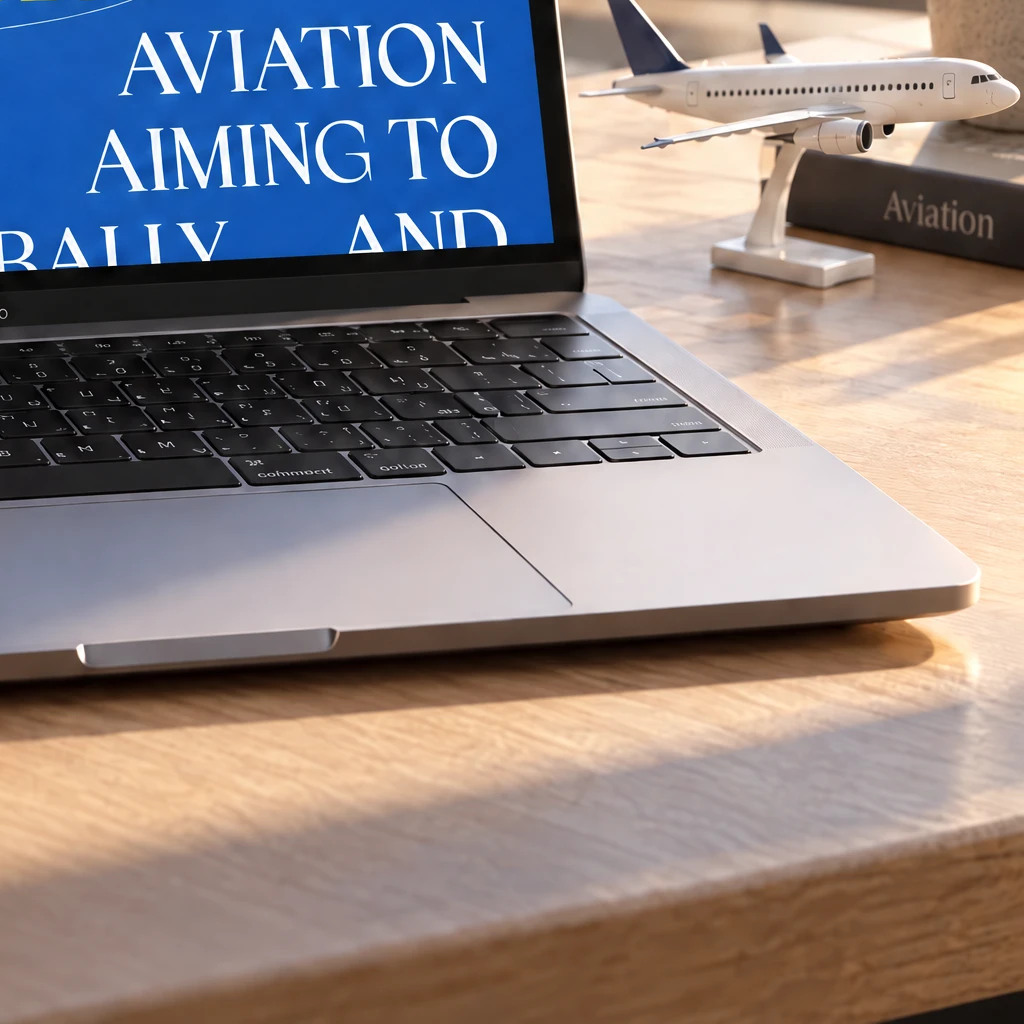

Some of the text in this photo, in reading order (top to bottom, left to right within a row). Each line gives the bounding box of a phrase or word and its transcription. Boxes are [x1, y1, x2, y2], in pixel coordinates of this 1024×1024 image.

[118, 20, 488, 96] AVIATION
[86, 119, 373, 195] AIMING
[387, 115, 499, 181] TO
[348, 209, 508, 255] AND
[883, 190, 994, 240] Aviation
